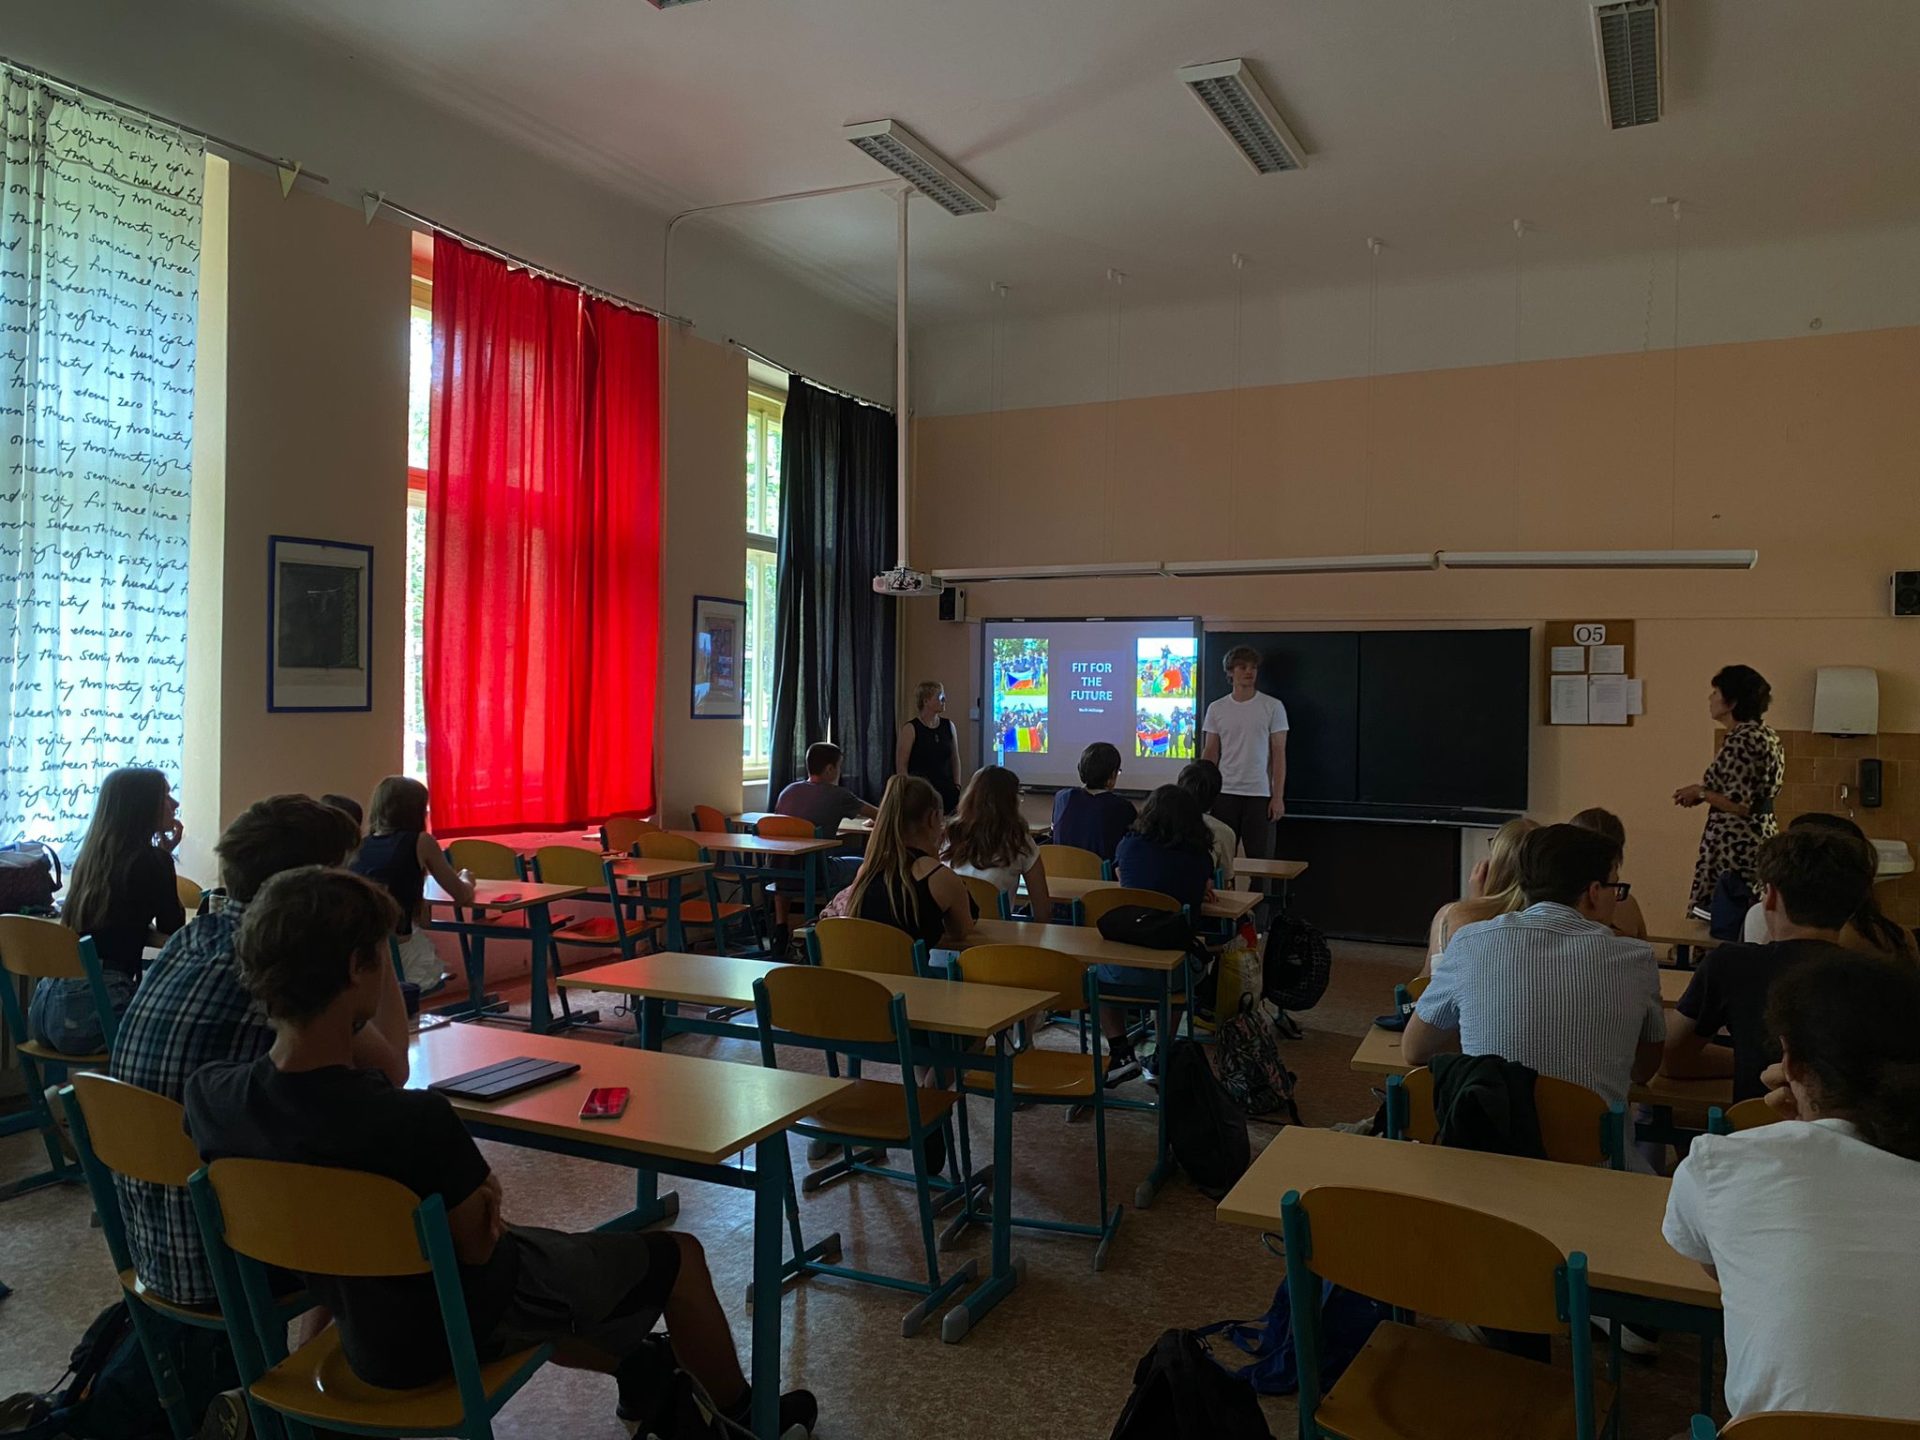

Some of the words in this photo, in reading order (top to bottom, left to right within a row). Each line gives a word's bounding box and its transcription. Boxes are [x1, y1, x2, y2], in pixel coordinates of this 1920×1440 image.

[1072, 662, 1088, 673] FIT
[1090, 662, 1112, 673] FOR
[1081, 677, 1102, 687] THE
[1071, 690, 1113, 701] FUTURE
